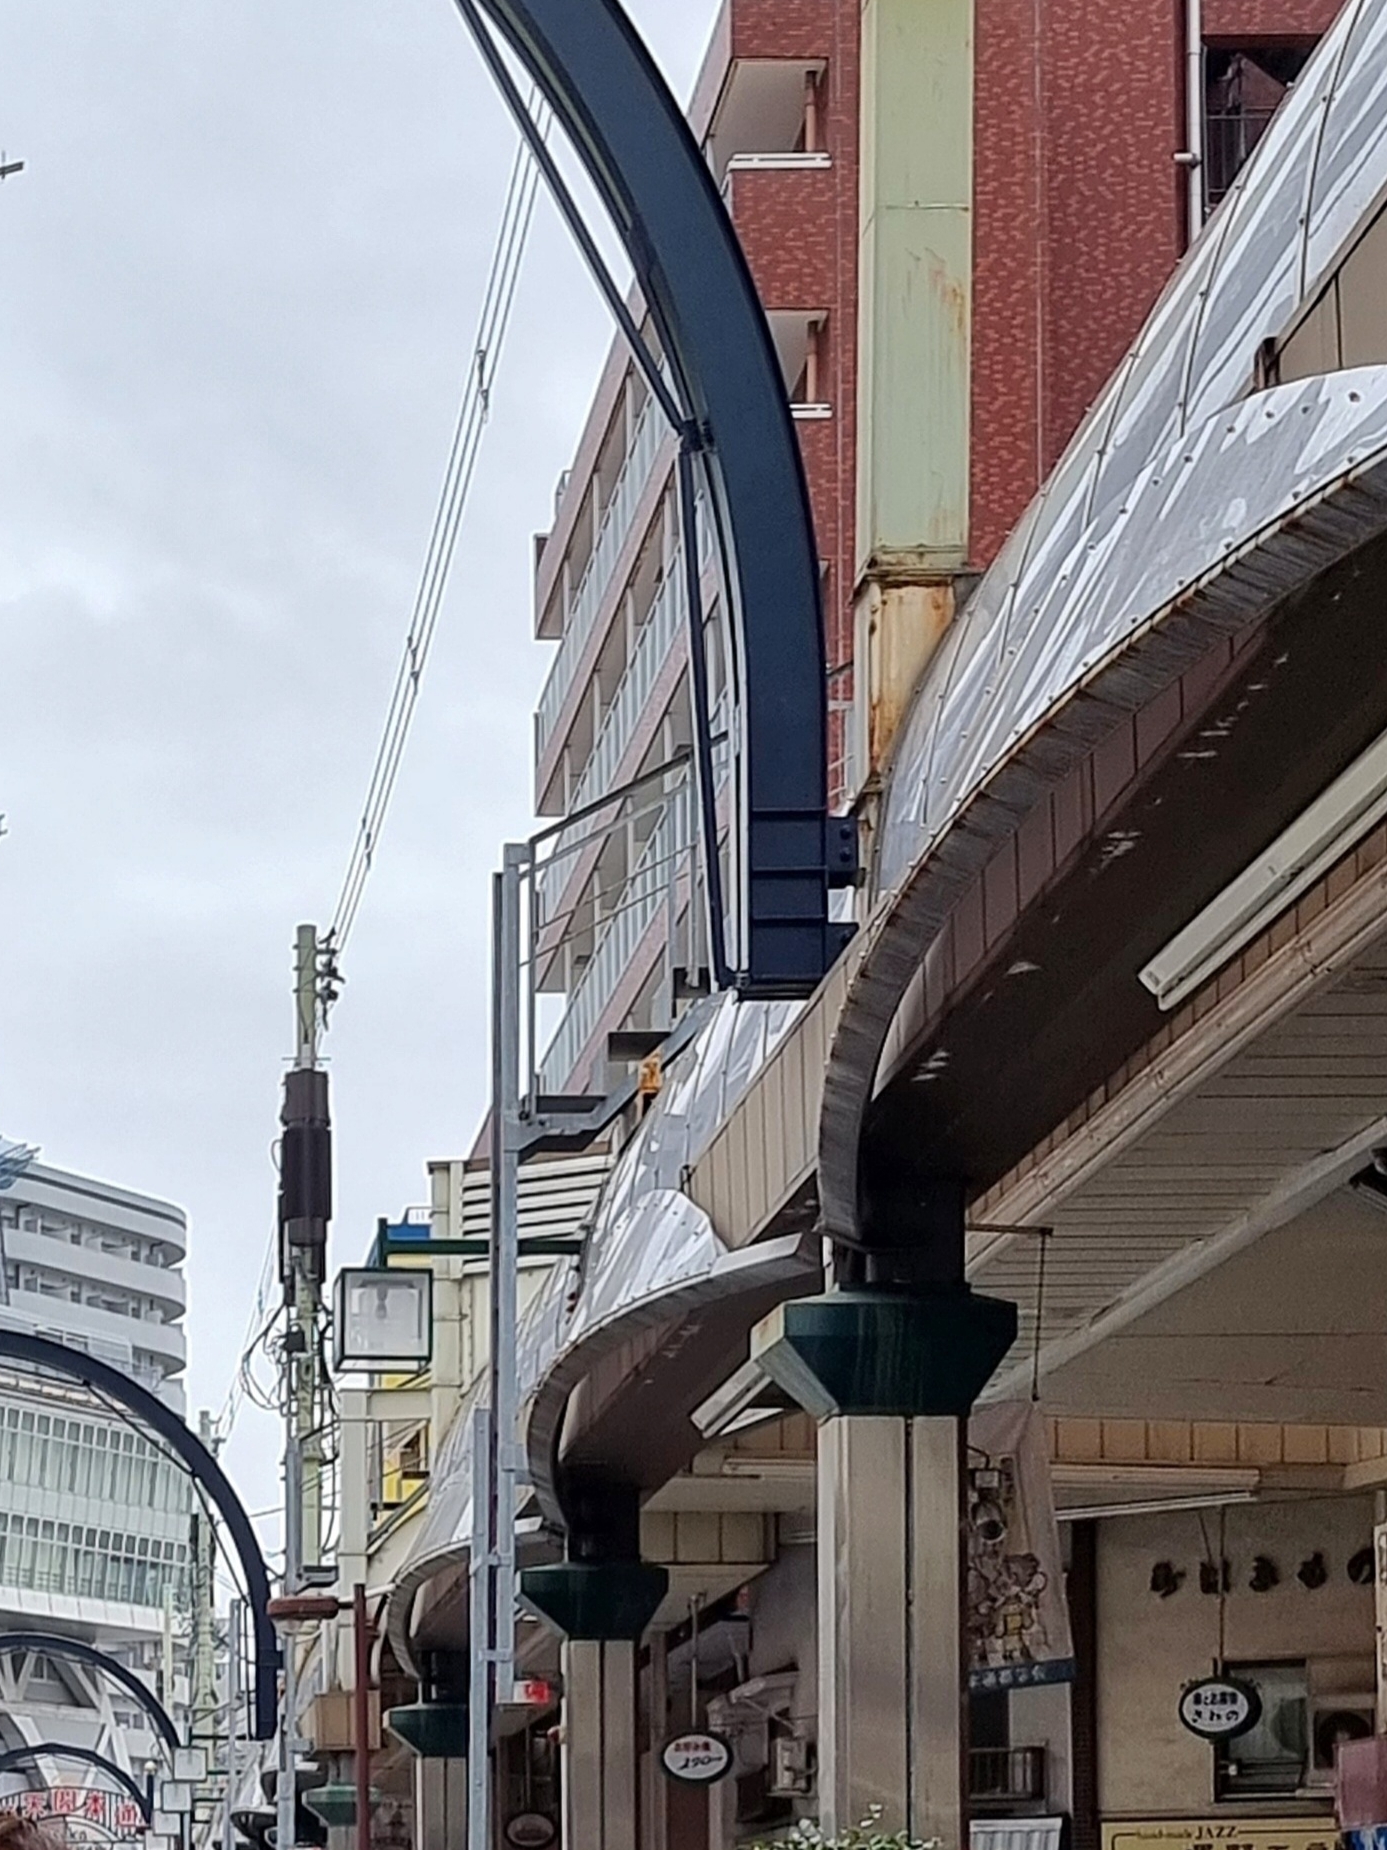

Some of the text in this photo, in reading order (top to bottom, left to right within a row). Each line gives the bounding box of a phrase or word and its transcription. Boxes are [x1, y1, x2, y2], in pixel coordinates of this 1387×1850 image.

[3, 1787, 138, 1829] 天閣本通
[1194, 1826, 1238, 1840] JAZZ
